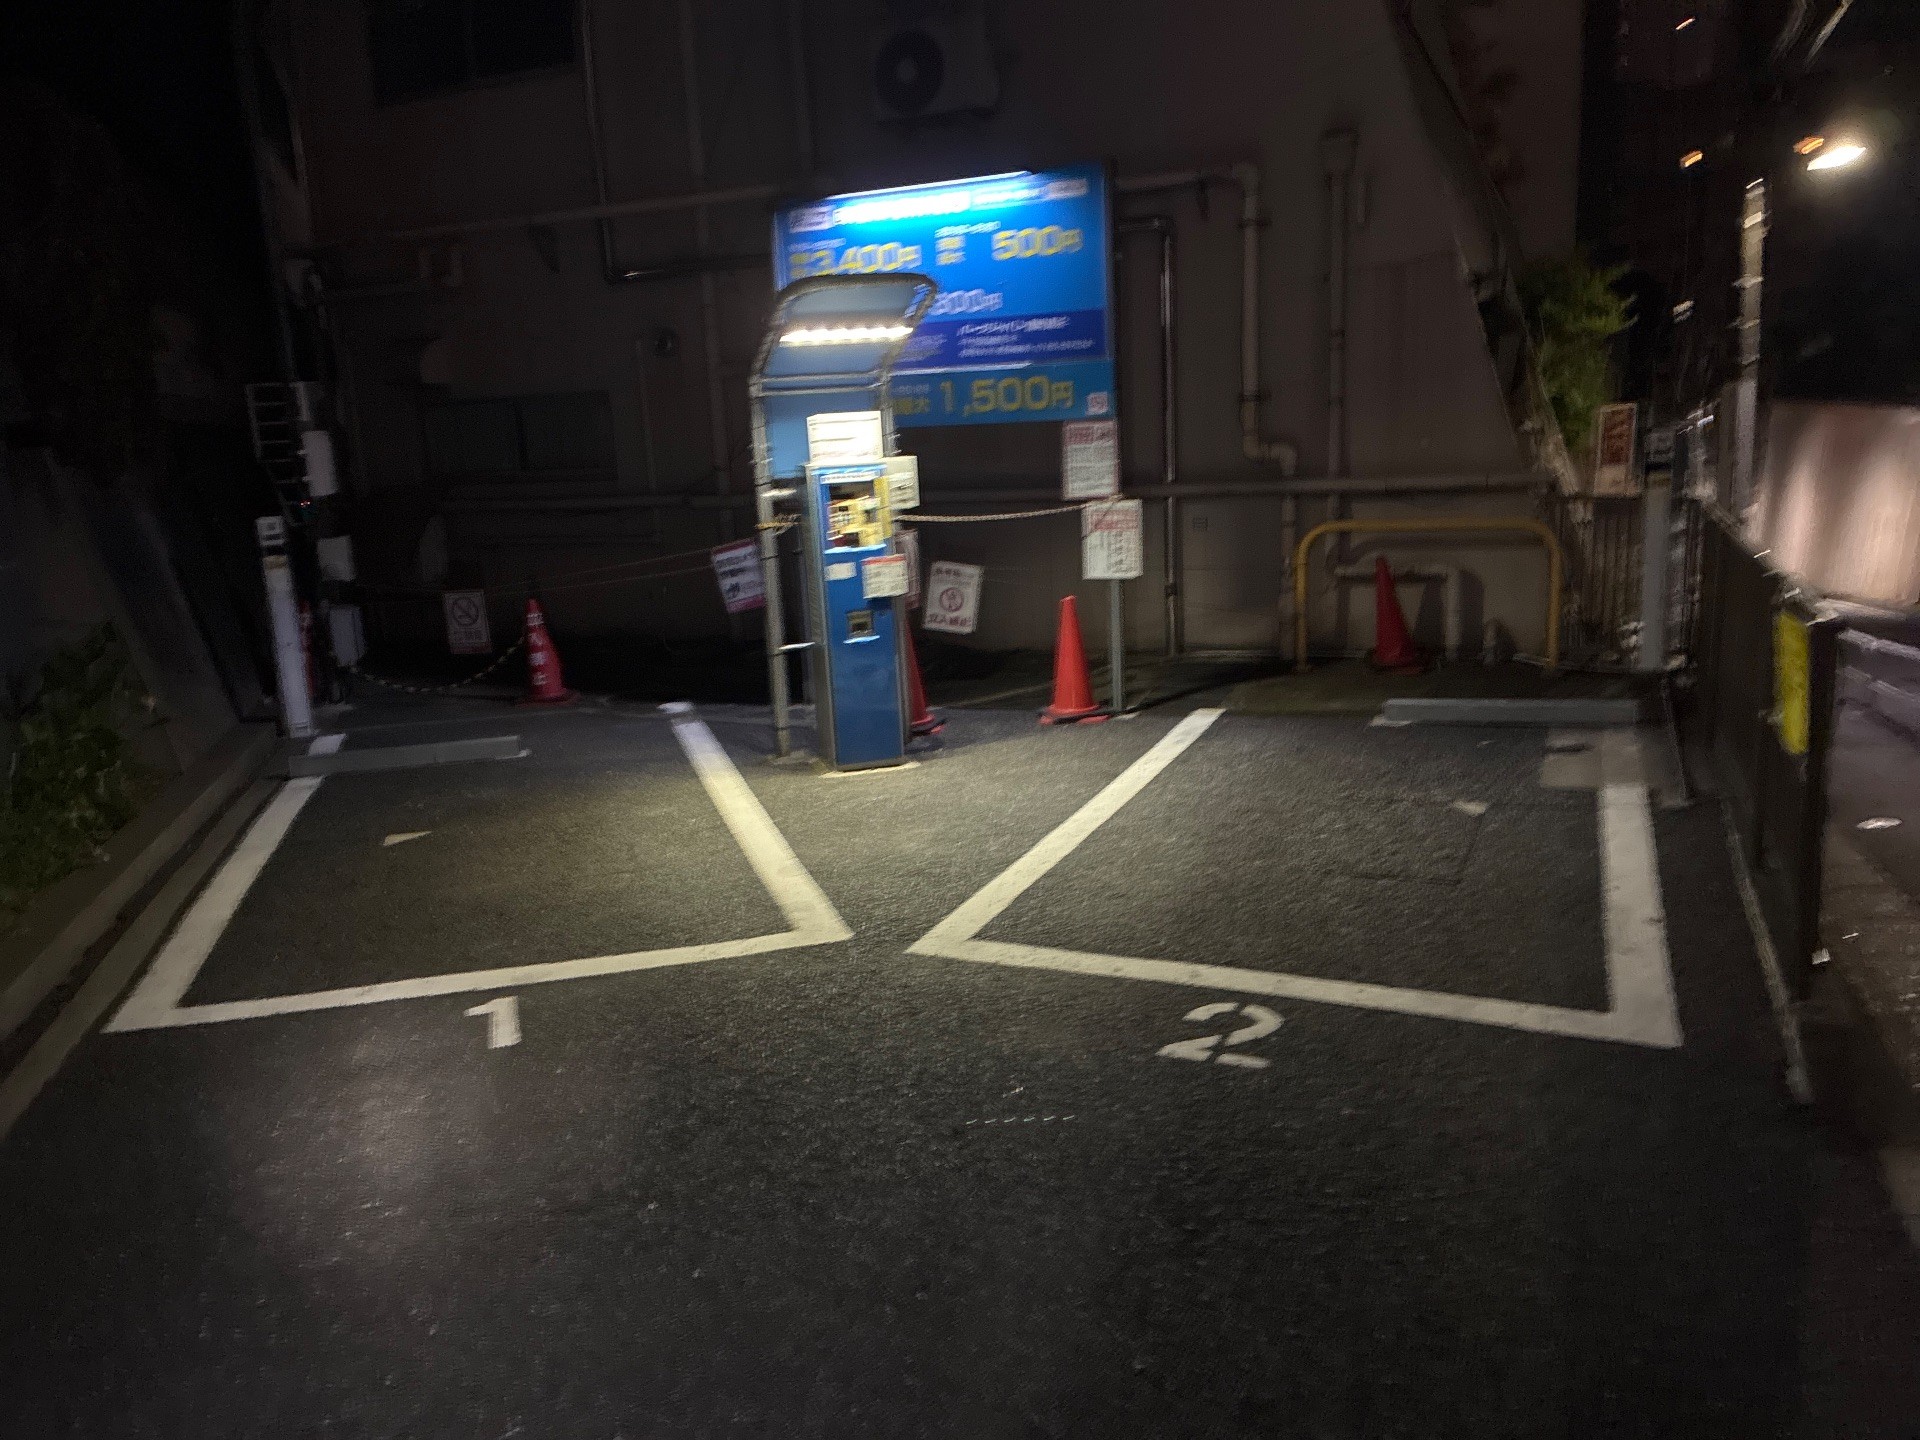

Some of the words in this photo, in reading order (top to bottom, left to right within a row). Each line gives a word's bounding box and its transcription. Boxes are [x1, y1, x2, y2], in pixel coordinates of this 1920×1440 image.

[991, 225, 1083, 261] 500円
[939, 375, 1075, 417] 1,500円
[463, 995, 523, 1049] 1
[1155, 1002, 1284, 1068] 2
